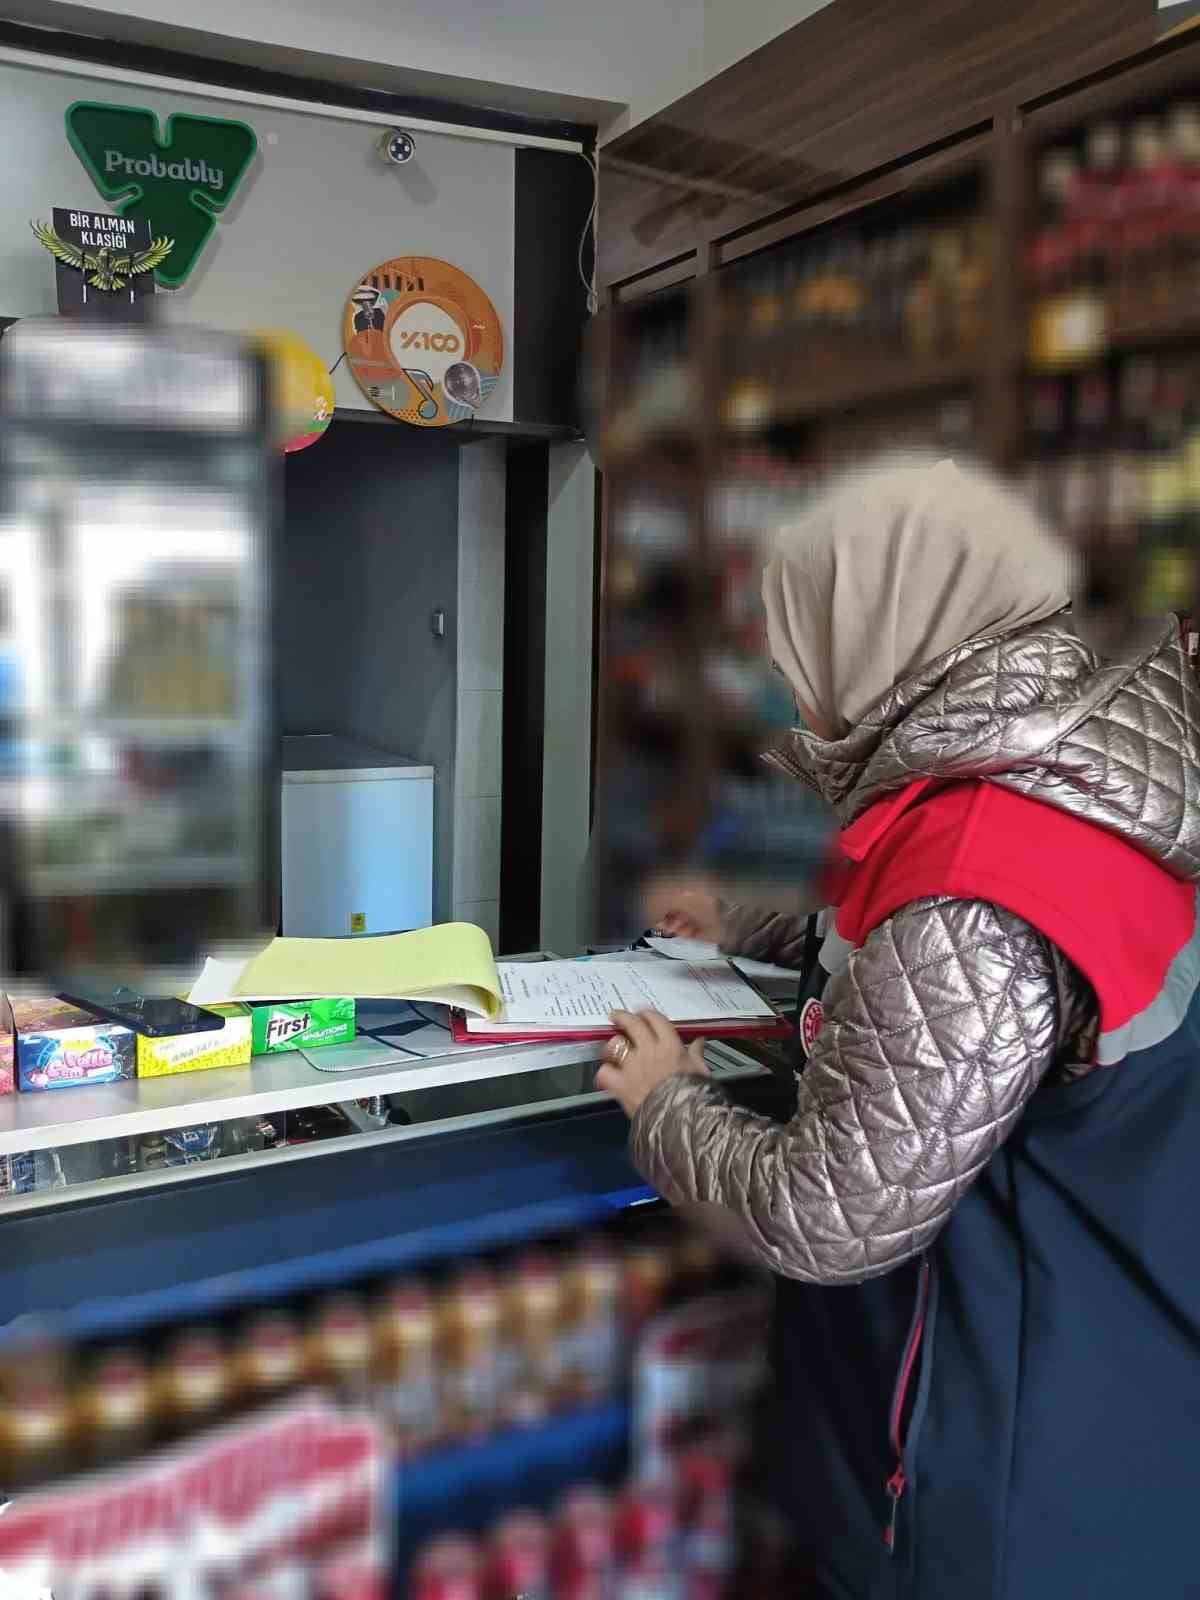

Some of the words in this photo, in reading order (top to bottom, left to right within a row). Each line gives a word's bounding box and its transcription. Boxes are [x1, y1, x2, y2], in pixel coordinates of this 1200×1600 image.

[104, 150, 224, 190] Probably
[69, 212, 90, 228] BİR
[94, 216, 136, 234] ALMAN
[81, 230, 127, 249] KLASİĞİ
[266, 1012, 310, 1043] First
